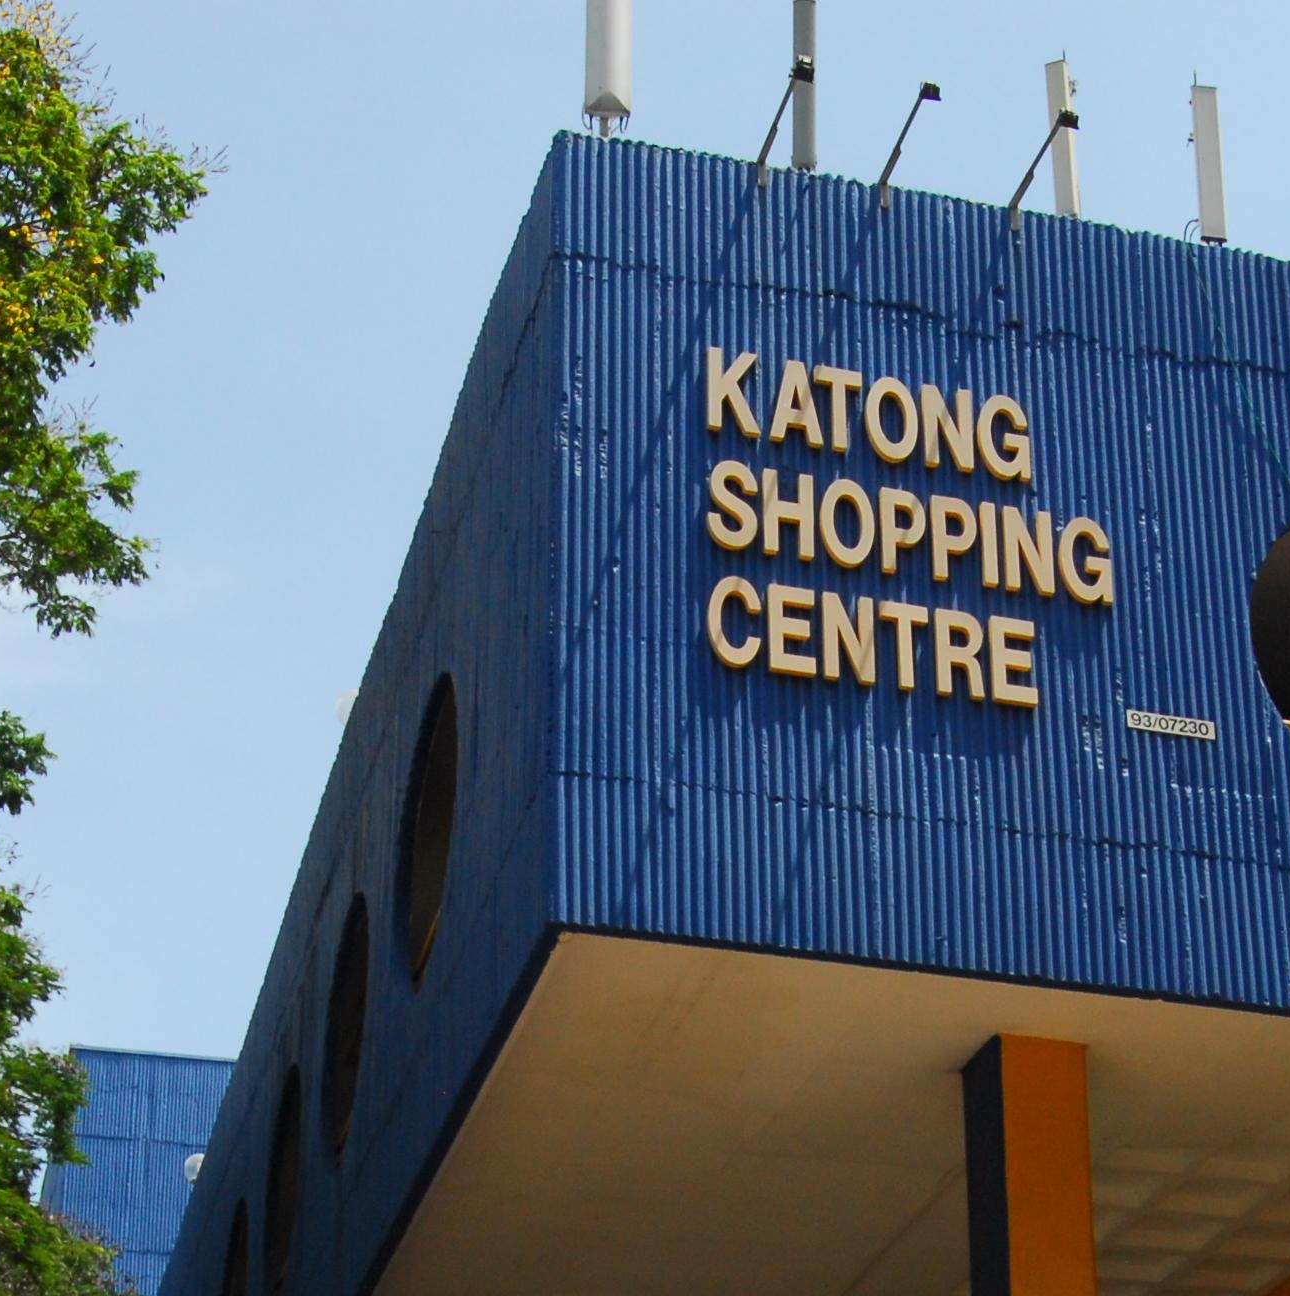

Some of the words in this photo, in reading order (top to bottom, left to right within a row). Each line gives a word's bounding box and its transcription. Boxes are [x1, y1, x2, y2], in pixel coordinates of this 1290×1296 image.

[707, 346, 1031, 483] KATONG
[707, 460, 1113, 603] SHOPPING
[707, 575, 1039, 708] CENTRE
[1130, 712, 1209, 736] 93/07230
